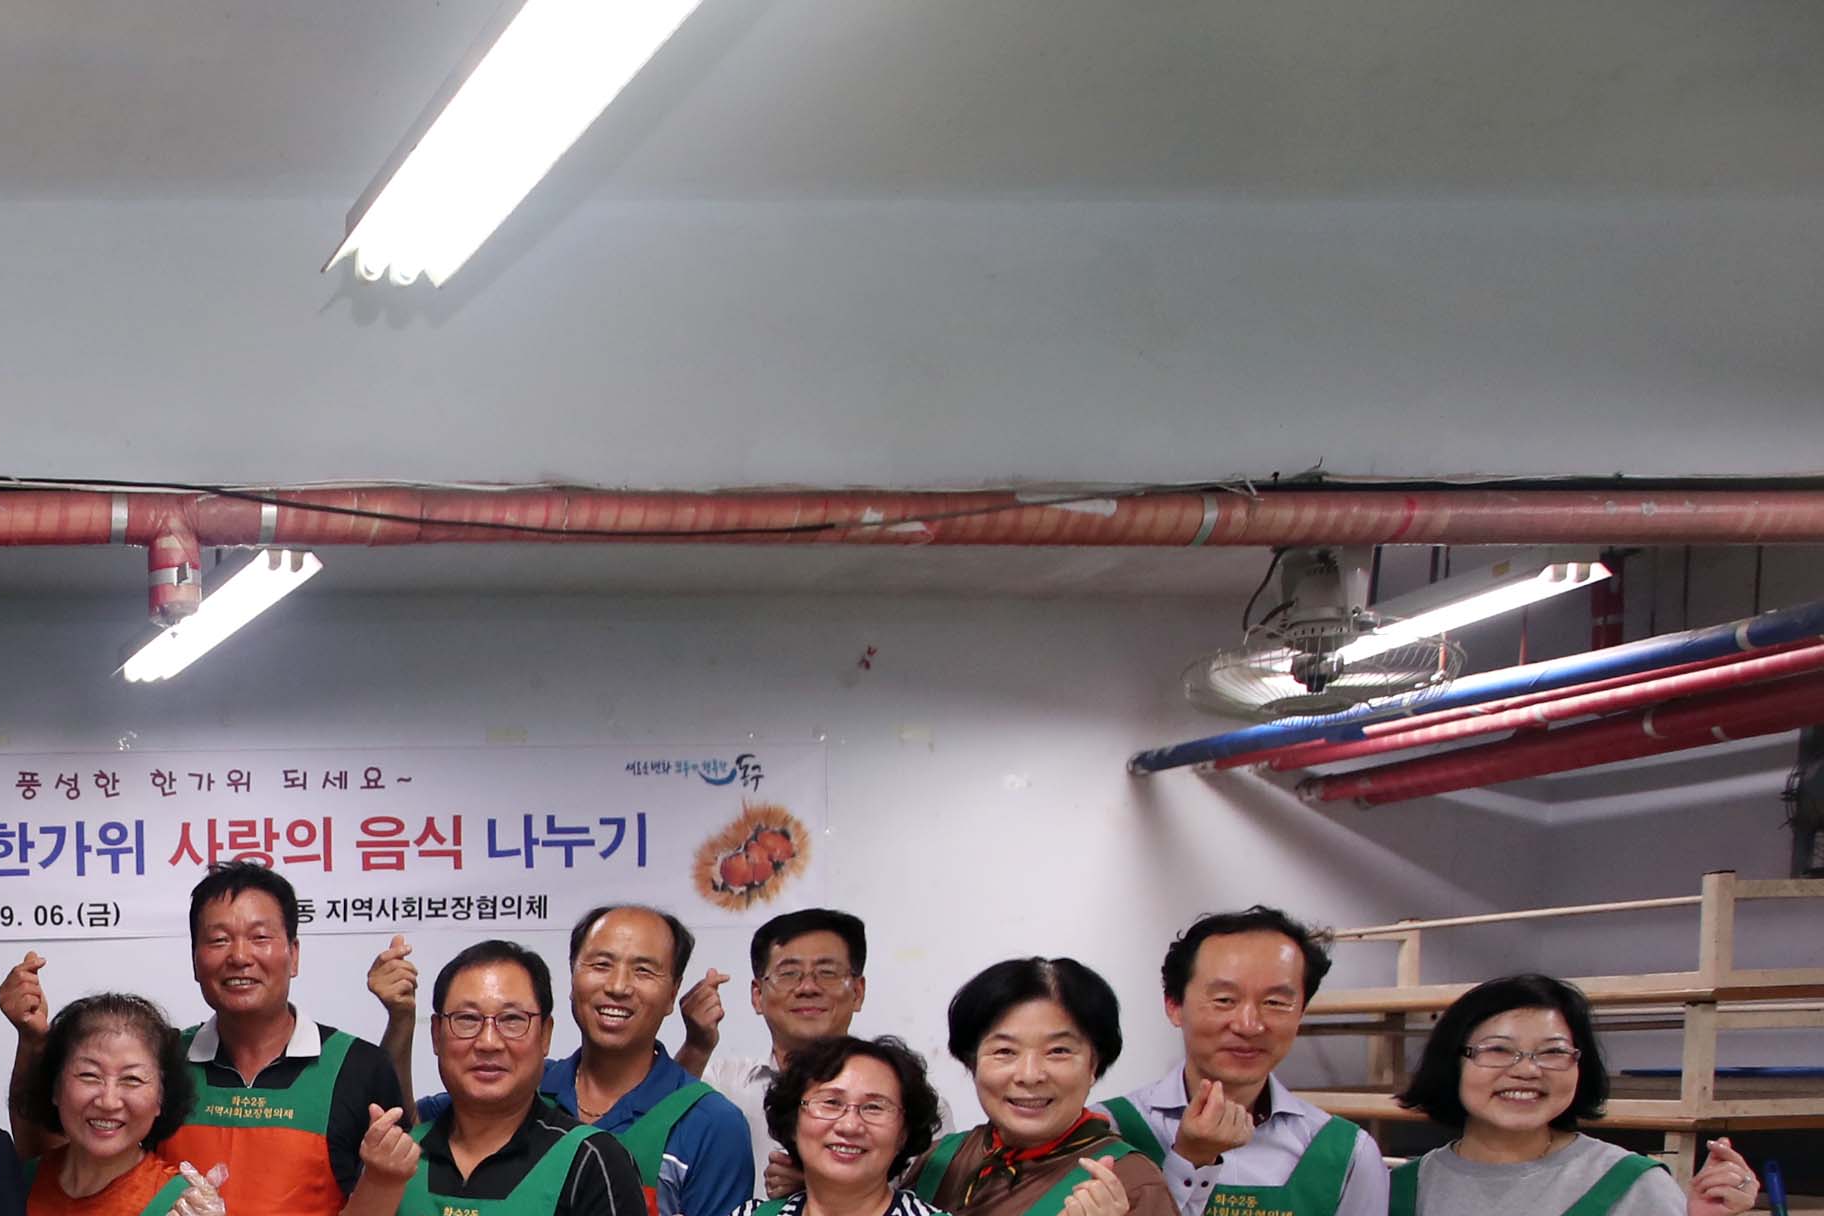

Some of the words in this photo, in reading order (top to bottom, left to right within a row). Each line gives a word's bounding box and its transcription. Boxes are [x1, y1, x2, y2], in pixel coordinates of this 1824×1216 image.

[15, 769, 122, 801] 풍성한
[150, 768, 253, 799] 한가위
[168, 816, 333, 874] 사랑의
[356, 814, 465, 870] 음식
[487, 811, 648, 869] 나누기
[325, 893, 549, 922] 지역사회보장협의체
[1215, 1193, 1257, 1208] 화수2동
